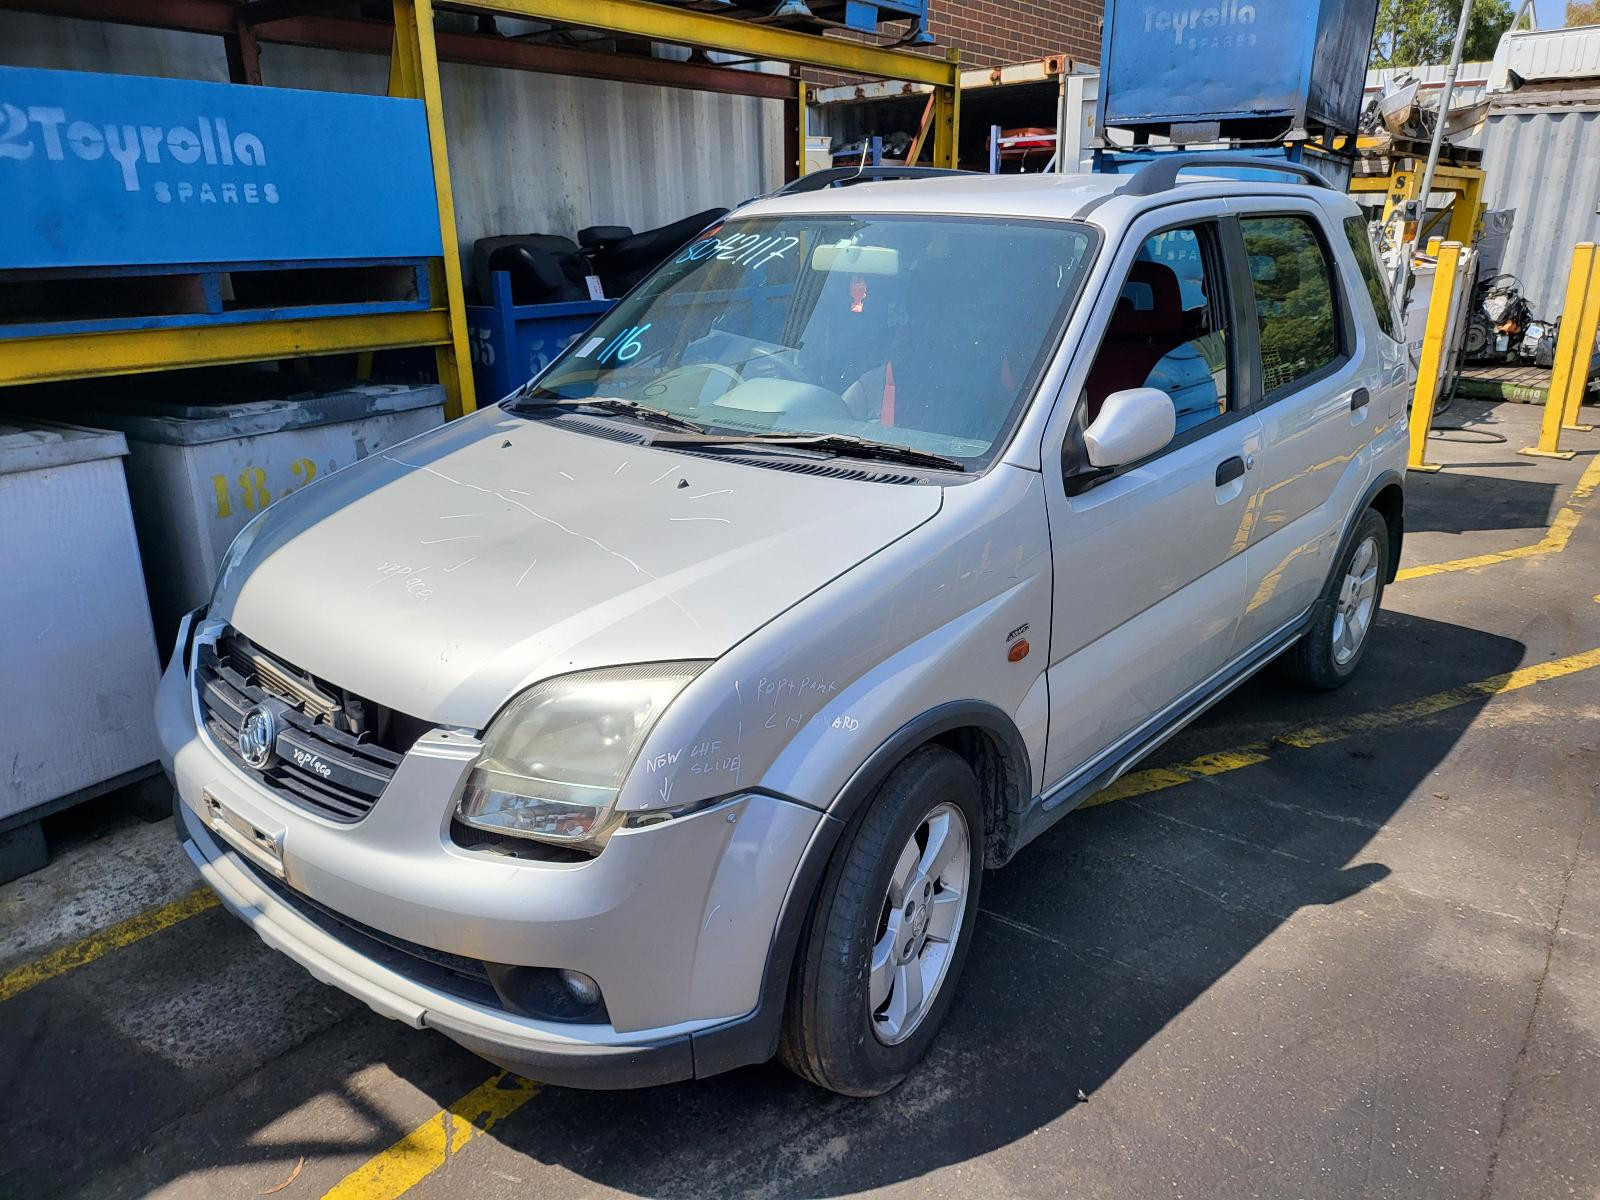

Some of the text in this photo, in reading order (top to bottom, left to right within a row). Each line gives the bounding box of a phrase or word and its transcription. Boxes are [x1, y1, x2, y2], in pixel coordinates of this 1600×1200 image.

[1143, 0, 1256, 46] Toyrolla
[154, 181, 280, 204] SPARES
[293, 748, 331, 779] replace
[646, 748, 682, 774] NEW
